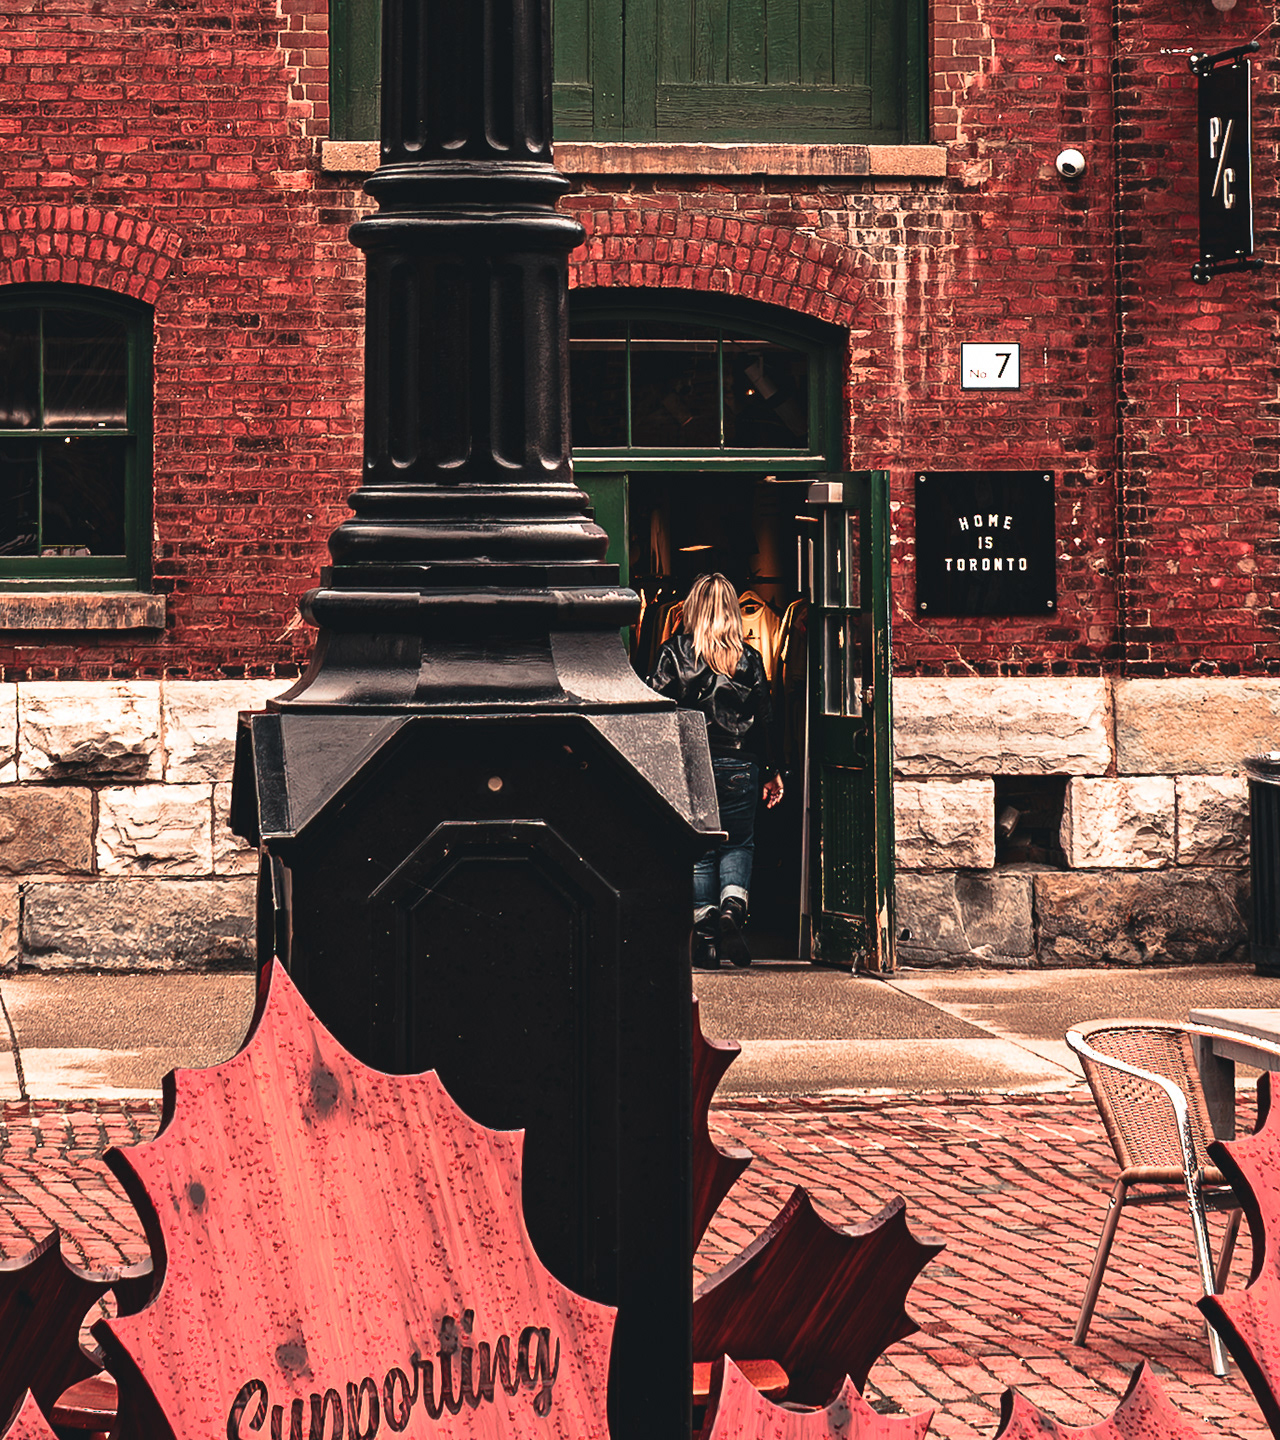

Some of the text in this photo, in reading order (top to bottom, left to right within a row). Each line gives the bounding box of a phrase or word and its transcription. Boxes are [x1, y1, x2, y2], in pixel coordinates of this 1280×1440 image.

[995, 353, 1012, 378] 7
[958, 514, 1013, 531] HOME
[978, 536, 993, 550] IS
[944, 557, 1027, 572] TORONTO
